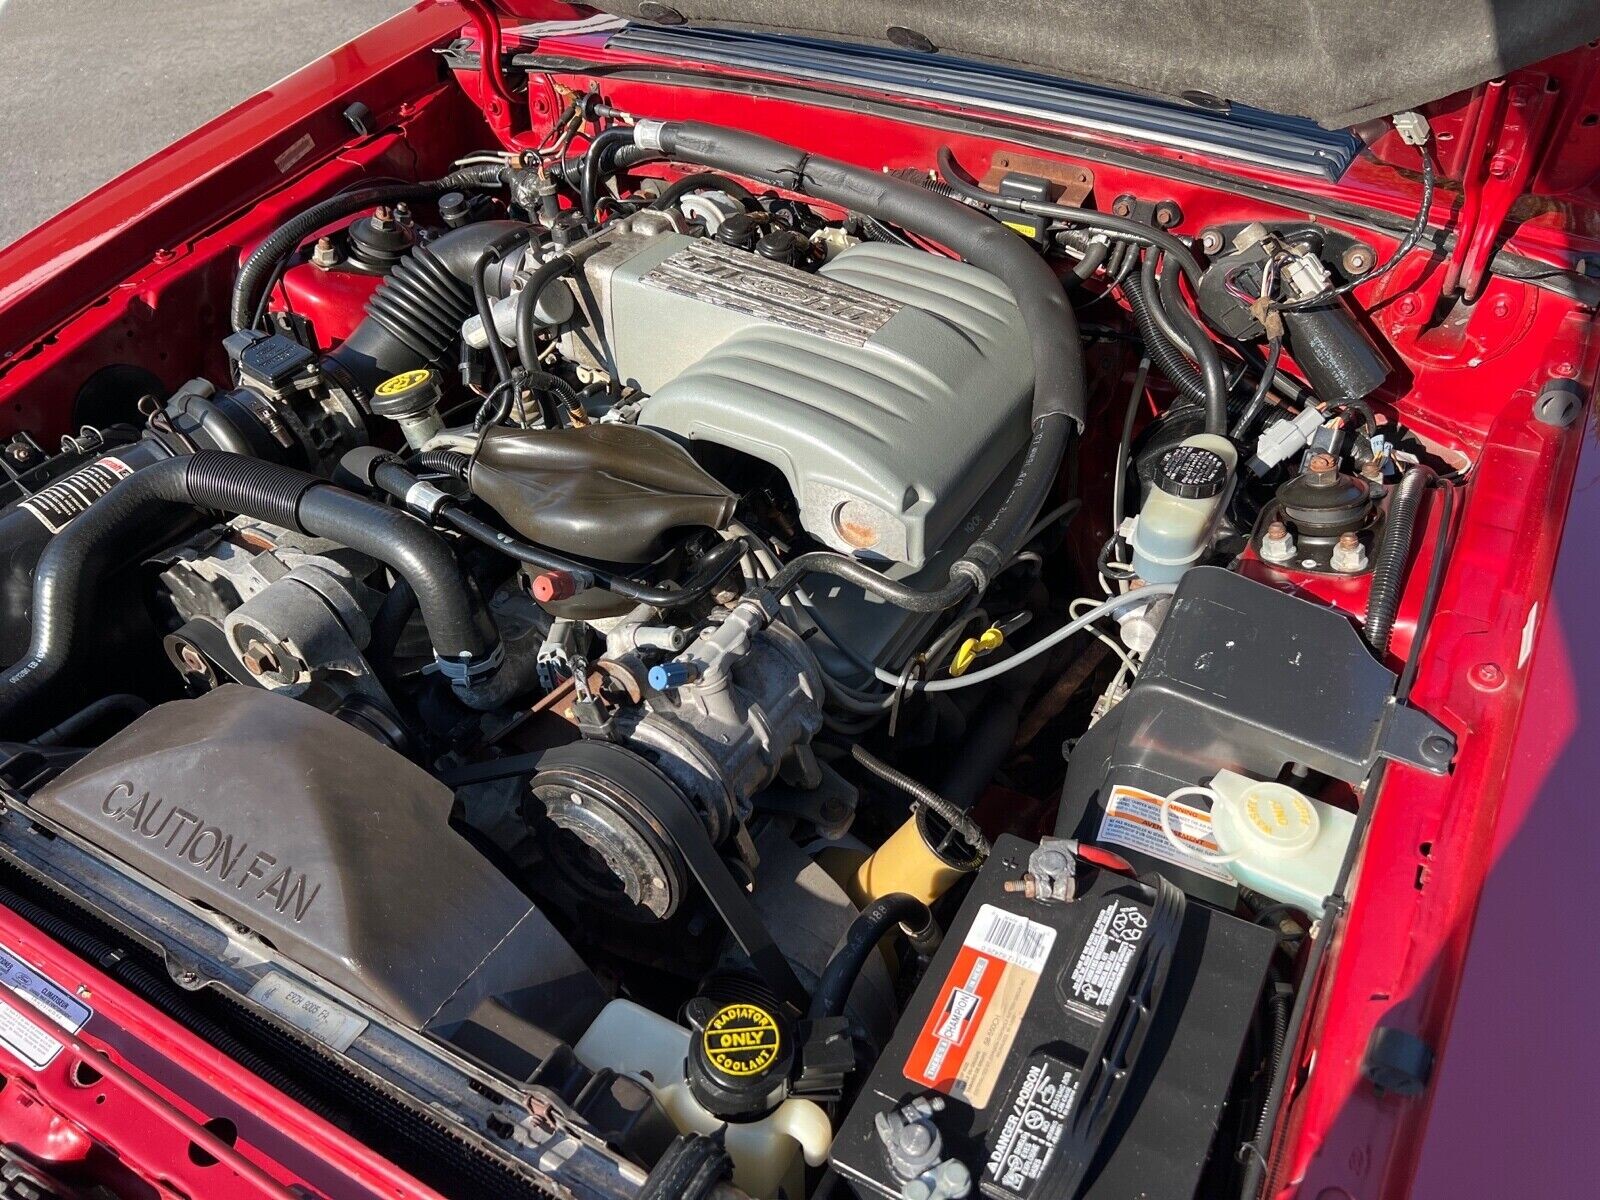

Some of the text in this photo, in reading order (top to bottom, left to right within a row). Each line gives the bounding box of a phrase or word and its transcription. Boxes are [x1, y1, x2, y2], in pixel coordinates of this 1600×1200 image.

[101, 779, 321, 923] CAUTION FAN
[713, 1008, 768, 1028] RADIATOR
[942, 992, 971, 1038] CHAMPION
[720, 1031, 763, 1047] ONLY
[716, 1049, 769, 1071] COOLANT
[990, 1113, 1020, 1162] DANGER
[1015, 1065, 1041, 1106] POISON
